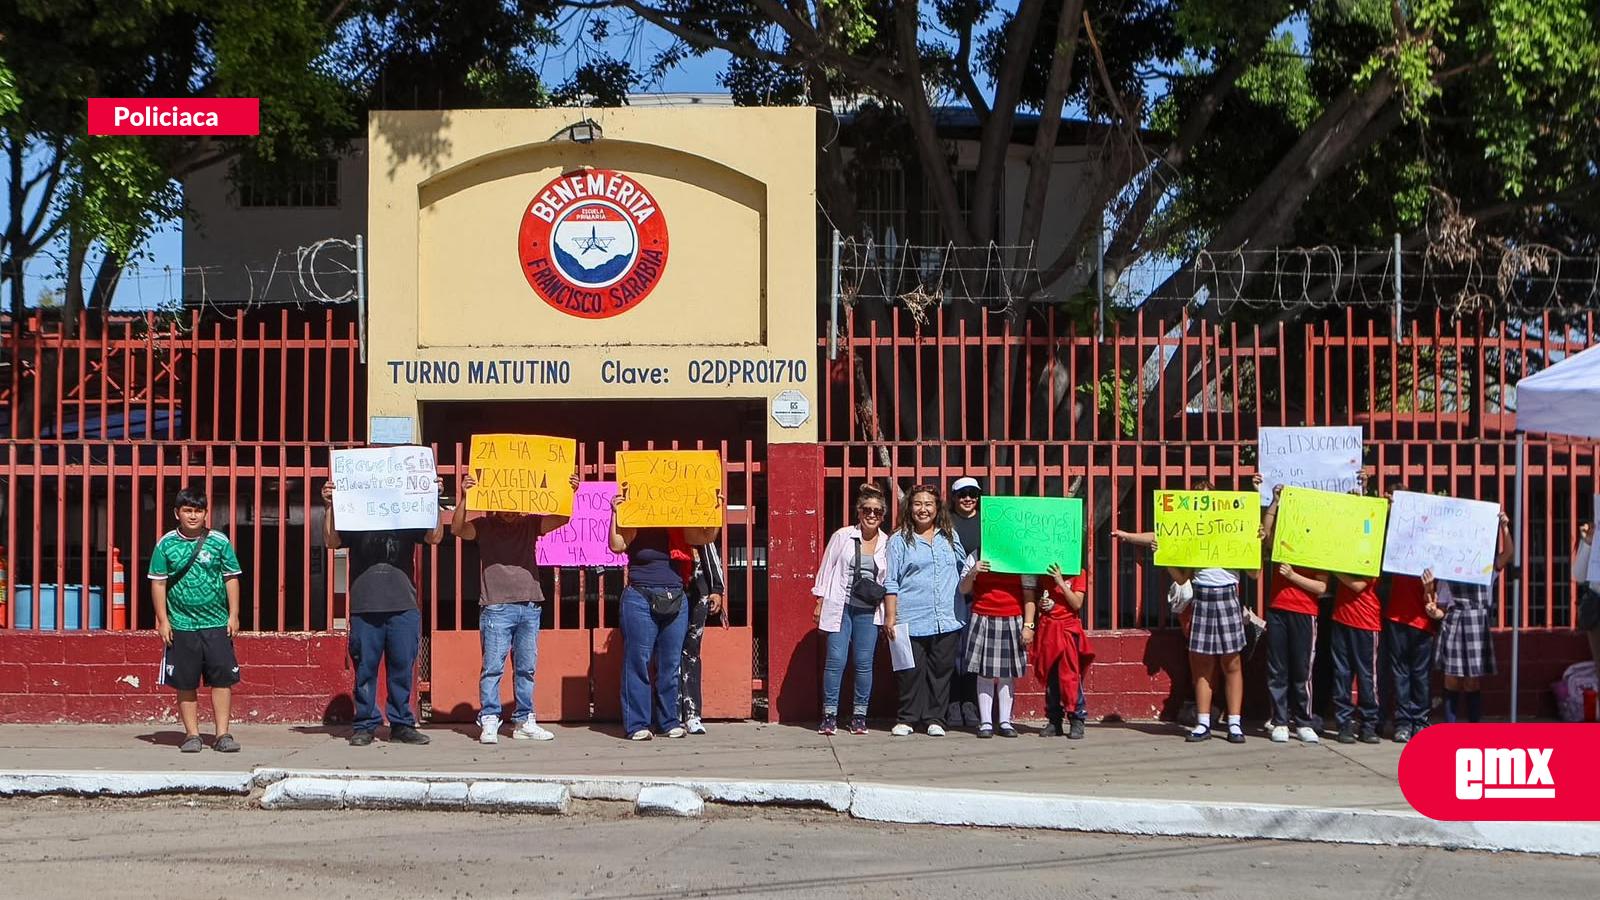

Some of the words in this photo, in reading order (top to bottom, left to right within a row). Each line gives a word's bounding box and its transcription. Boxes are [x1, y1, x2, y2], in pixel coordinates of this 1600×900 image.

[531, 173, 656, 225] BENEMÉRITA
[609, 249, 663, 308] SARABIA
[387, 361, 460, 384] TURNO
[468, 361, 570, 384] MATUTINO
[601, 360, 669, 384] Clave:
[475, 489, 559, 513] MAESTROS
